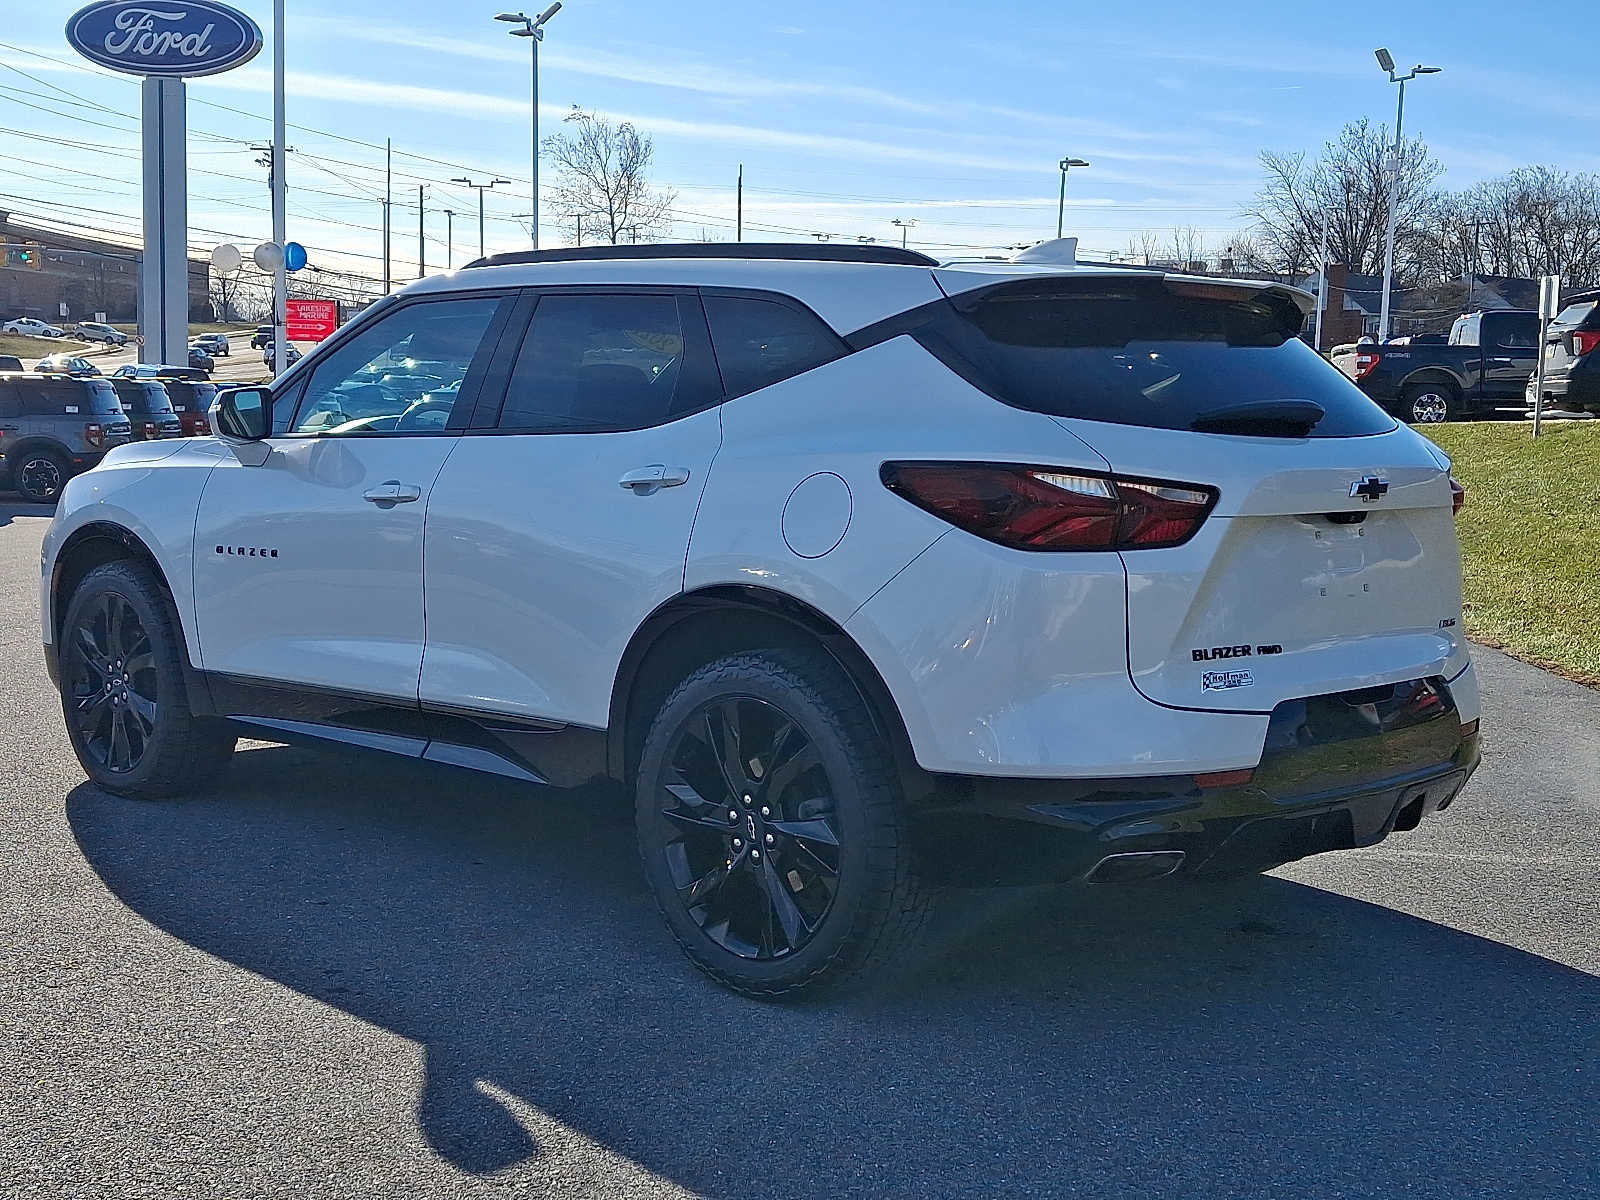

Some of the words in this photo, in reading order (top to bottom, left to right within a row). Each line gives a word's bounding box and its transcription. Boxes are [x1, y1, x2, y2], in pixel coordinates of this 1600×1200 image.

[104, 8, 215, 57] Ford
[215, 545, 279, 558] BLAZER
[1191, 644, 1252, 662] BLAZER
[1256, 644, 1283, 656] AWD
